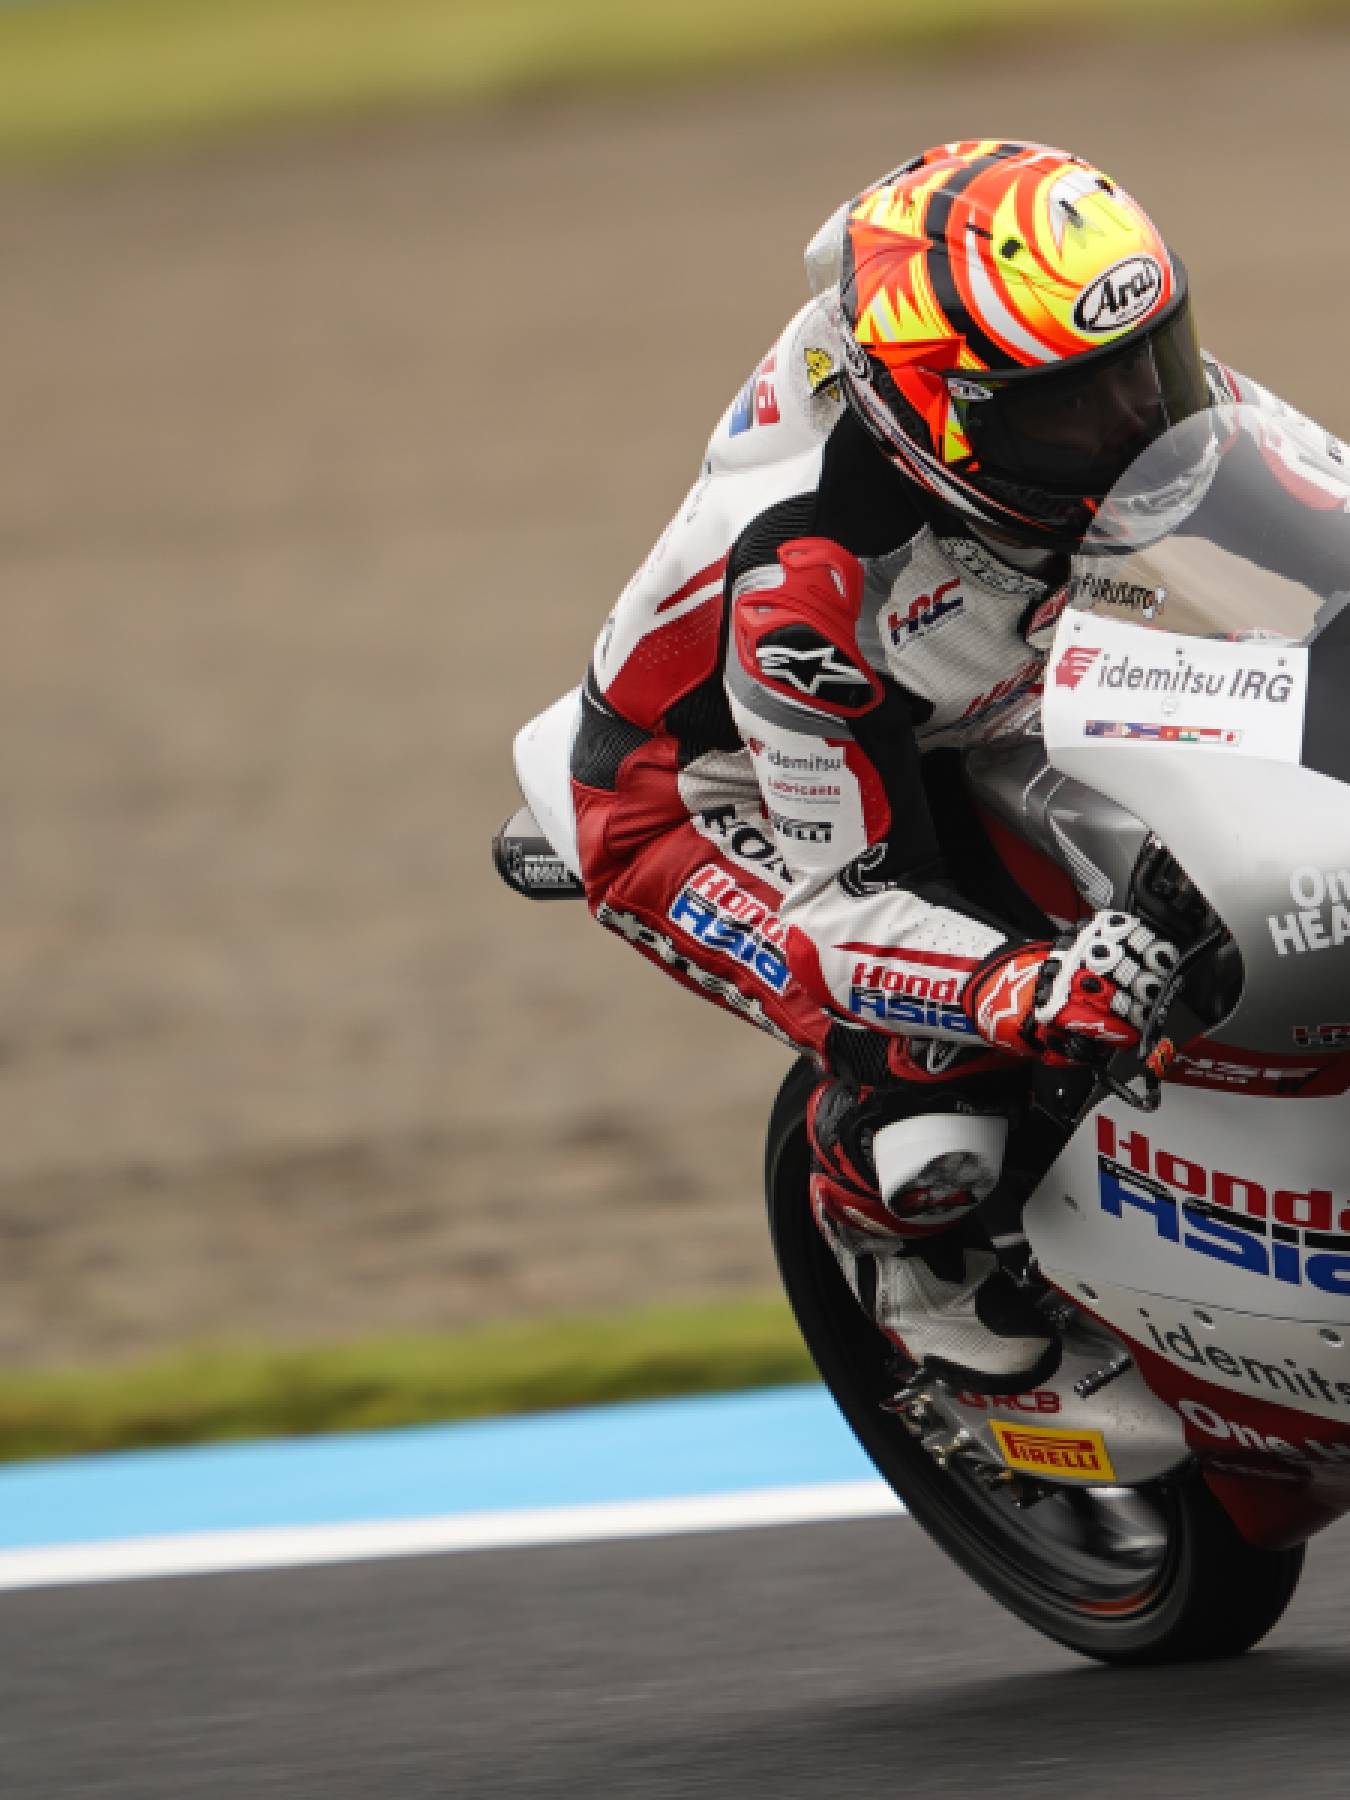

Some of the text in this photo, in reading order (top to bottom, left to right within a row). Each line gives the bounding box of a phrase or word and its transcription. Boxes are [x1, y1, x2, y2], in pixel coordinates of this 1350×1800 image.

[1086, 260, 1157, 325] Arai
[887, 576, 964, 646] HRC
[1098, 653, 1294, 703] idemitsu IRG
[852, 962, 962, 1002] Hond
[1001, 1430, 1102, 1471] PIRELLI
